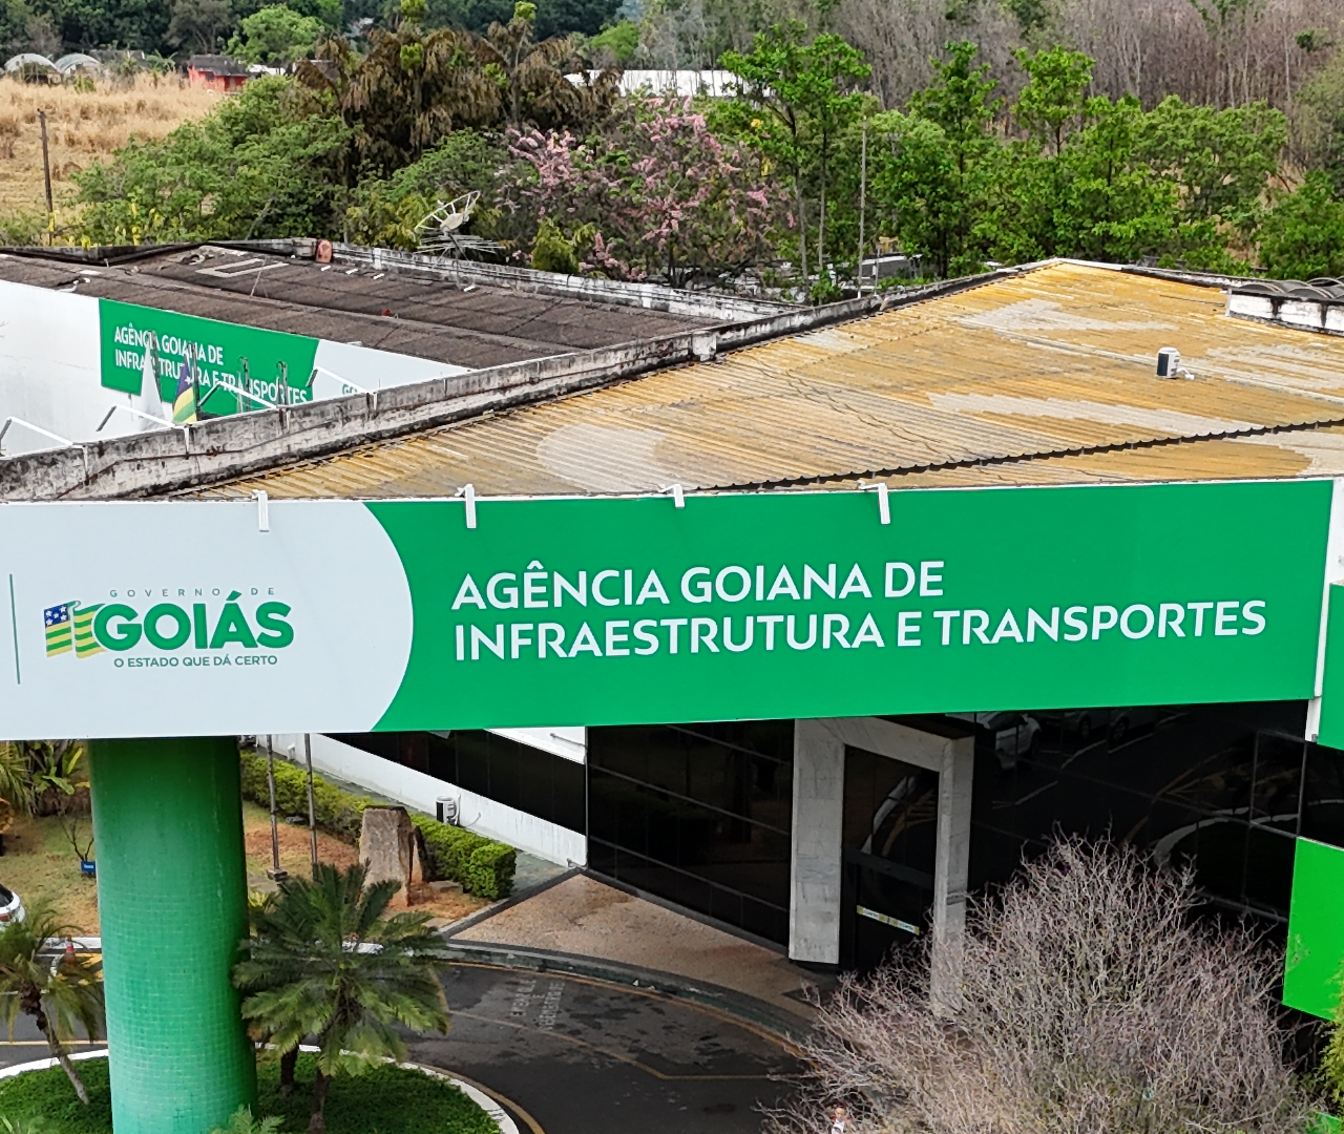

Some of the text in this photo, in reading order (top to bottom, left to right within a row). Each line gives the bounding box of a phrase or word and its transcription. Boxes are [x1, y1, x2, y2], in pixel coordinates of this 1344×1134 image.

[208, 346, 224, 365] DE
[110, 587, 274, 598] GOVERNO DE
[452, 560, 944, 610] AGÊNCIA GOIANA DE
[93, 590, 294, 651] GOIÁS
[454, 600, 1266, 661] INFRAESTRUTURA E TRANSPORTES
[114, 653, 277, 668] O ESTADO QUE DÁ CERTO
